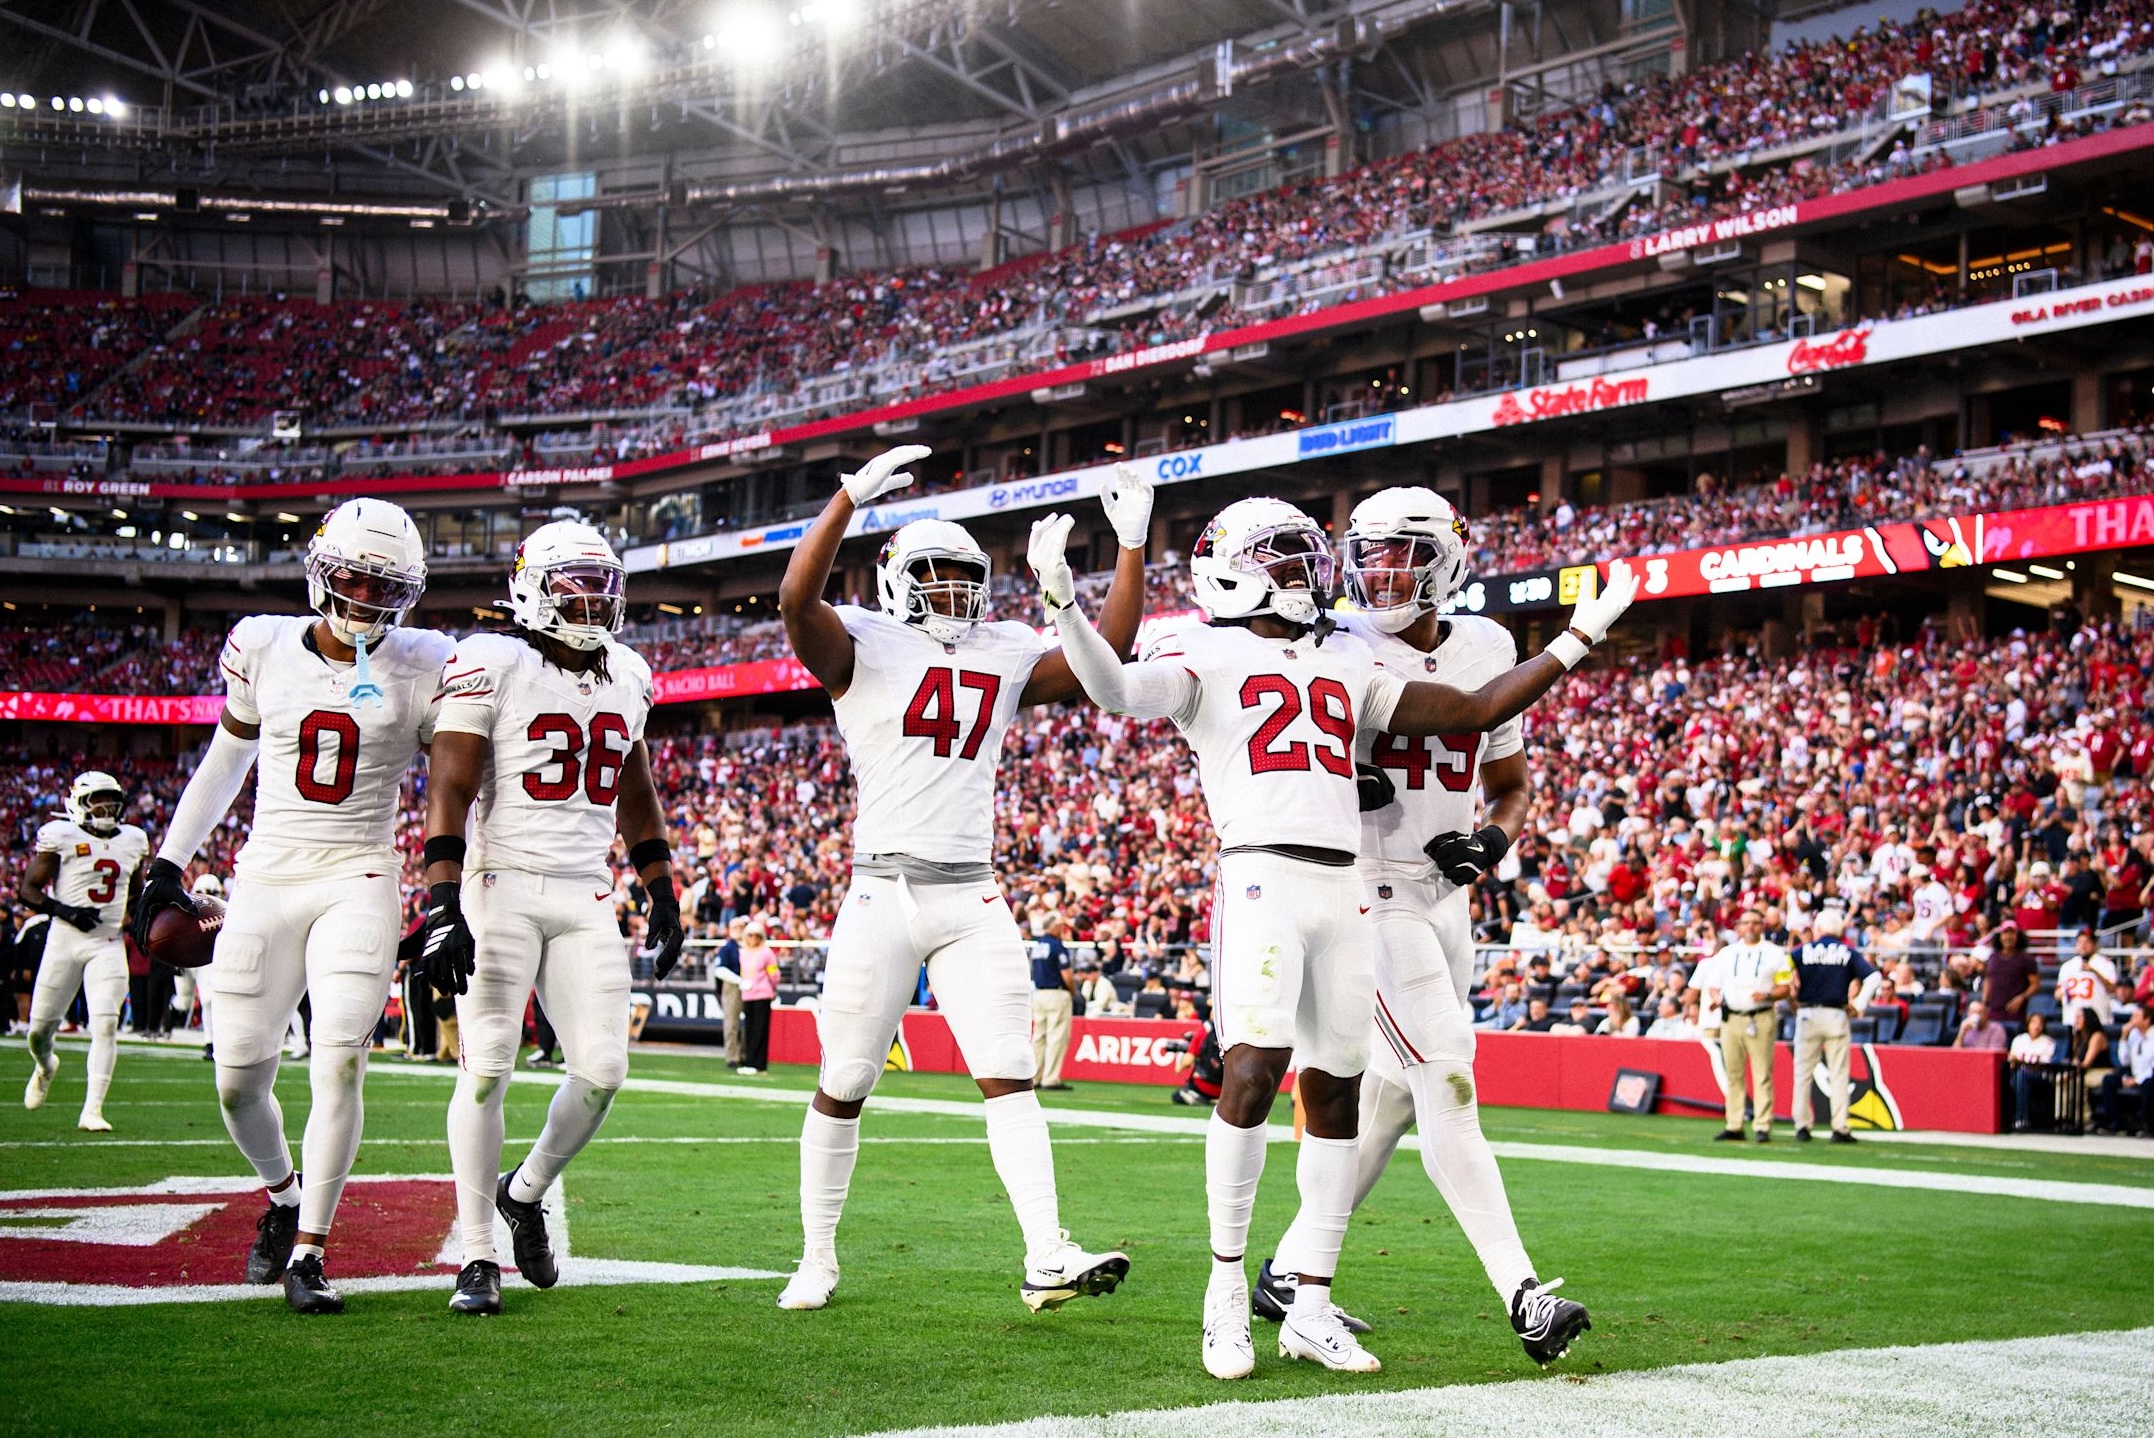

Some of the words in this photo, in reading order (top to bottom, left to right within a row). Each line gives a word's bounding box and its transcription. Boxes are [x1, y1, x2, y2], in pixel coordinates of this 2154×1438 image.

[1645, 224, 1710, 256] LARRY
[1715, 205, 1798, 239] WILSON
[1158, 453, 1203, 480] COX
[63, 480, 95, 494] ROY
[99, 482, 150, 496] GREEN
[1013, 478, 1078, 500] HYUNDAI
[1700, 534, 1864, 581] CARDINALS
[708, 672, 735, 690] BALL
[108, 698, 191, 722] THAT'S
[903, 667, 1001, 761] 47
[1239, 673, 1355, 780] 29
[295, 709, 360, 805] 0
[522, 712, 630, 806] 36
[88, 858, 120, 903] 3
[2066, 978, 2094, 999] 23
[1075, 1034, 1182, 1067] ARIZO
